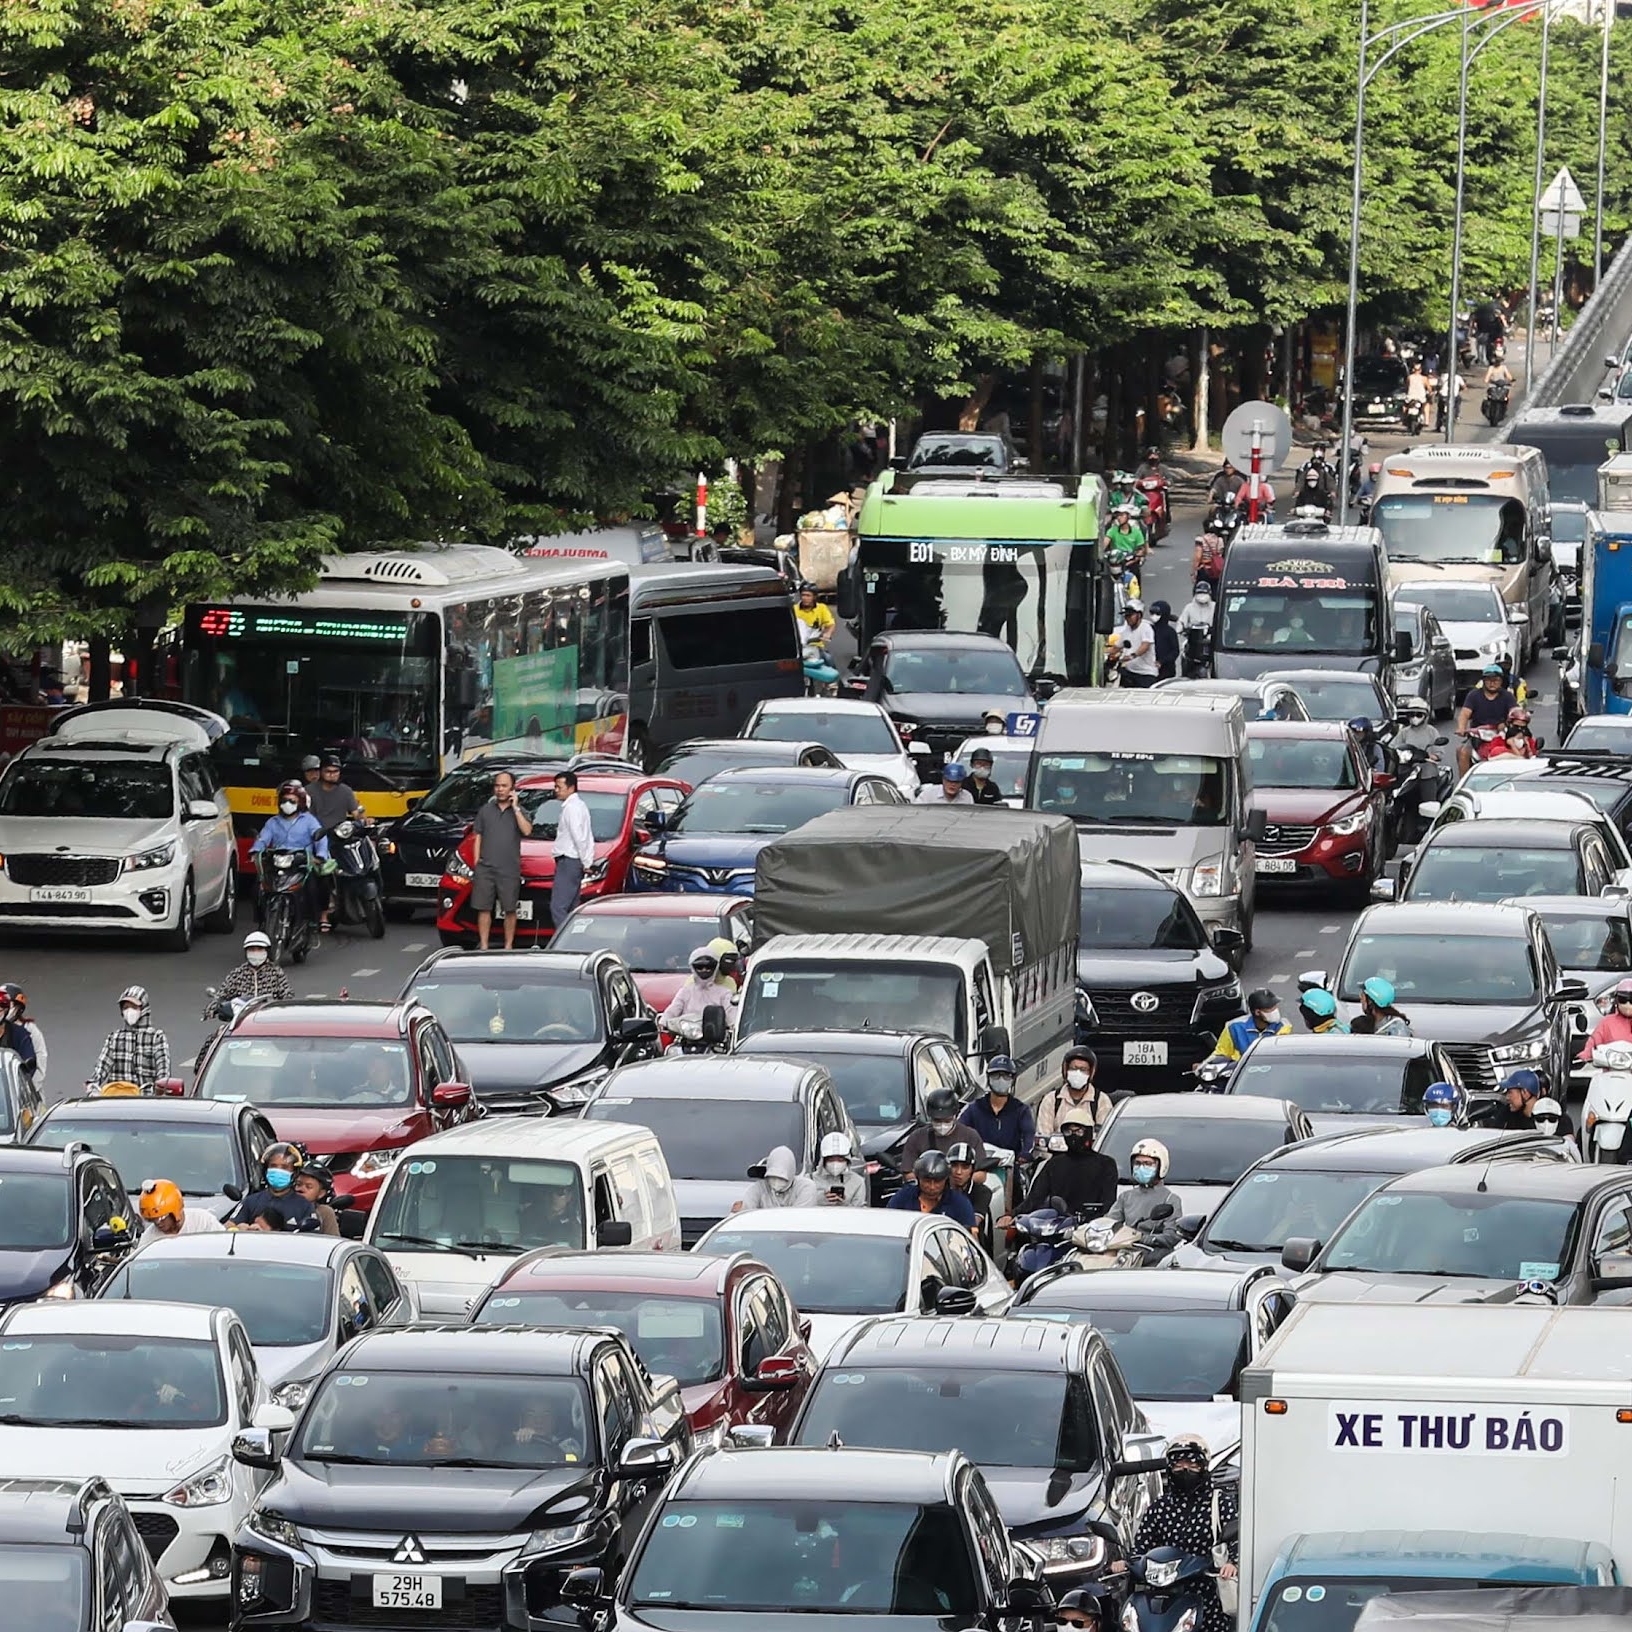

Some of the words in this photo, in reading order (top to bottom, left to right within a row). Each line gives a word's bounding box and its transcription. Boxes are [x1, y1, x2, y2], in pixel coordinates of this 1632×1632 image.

[909, 542, 933, 563] E01
[950, 547, 968, 561] BX
[969, 544, 988, 561] MỸ
[990, 544, 1018, 562] ĐÌNH
[1137, 1044, 1155, 1053] 18A
[1334, 1413, 1383, 1447] XE
[1397, 1412, 1476, 1448] THƯ
[1485, 1410, 1564, 1452] BÁO
[393, 1575, 423, 1591] 29H
[380, 1591, 435, 1607] 575.48
